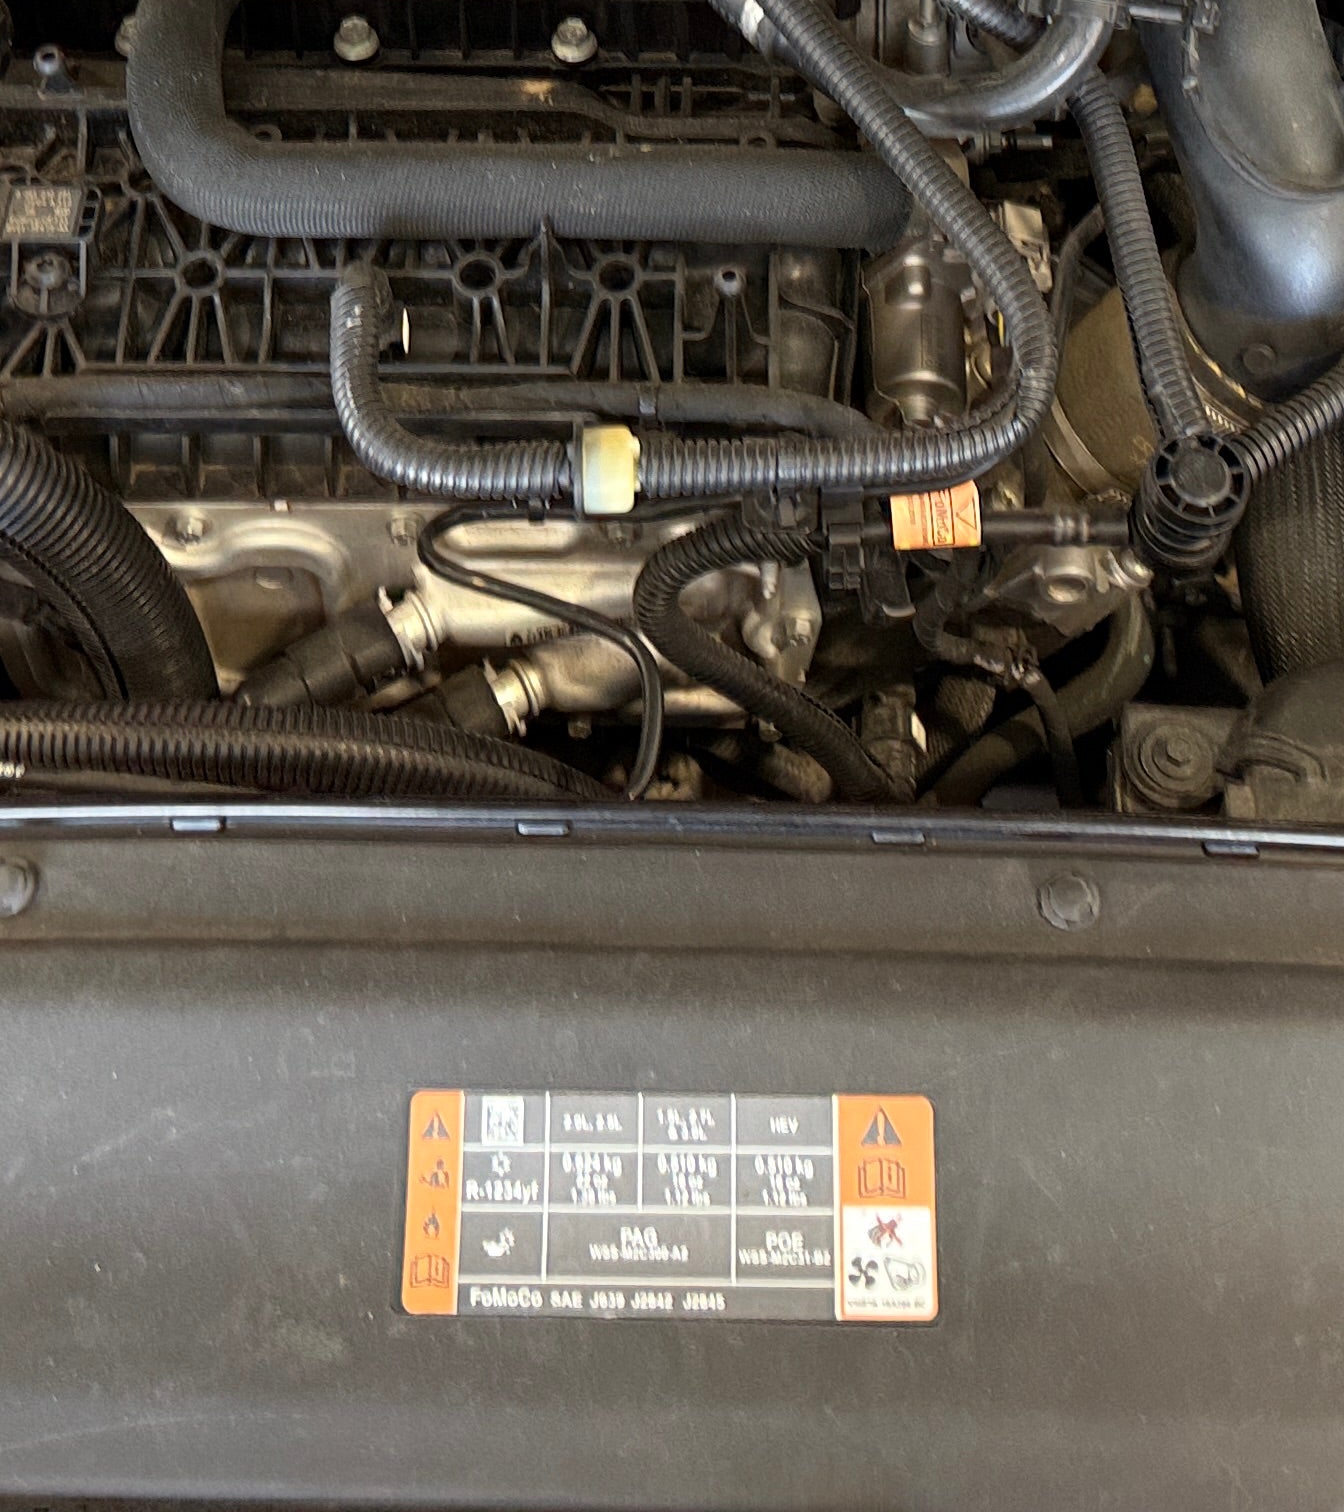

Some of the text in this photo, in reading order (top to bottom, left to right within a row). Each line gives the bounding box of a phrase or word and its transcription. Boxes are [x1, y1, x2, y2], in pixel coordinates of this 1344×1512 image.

[769, 1116, 799, 1135] HEV
[603, 1151, 622, 1178] kg
[699, 1153, 717, 1179] kg
[795, 1155, 814, 1180] kg
[470, 1286, 543, 1308] FoMoCo
[550, 1290, 583, 1309] SAE
